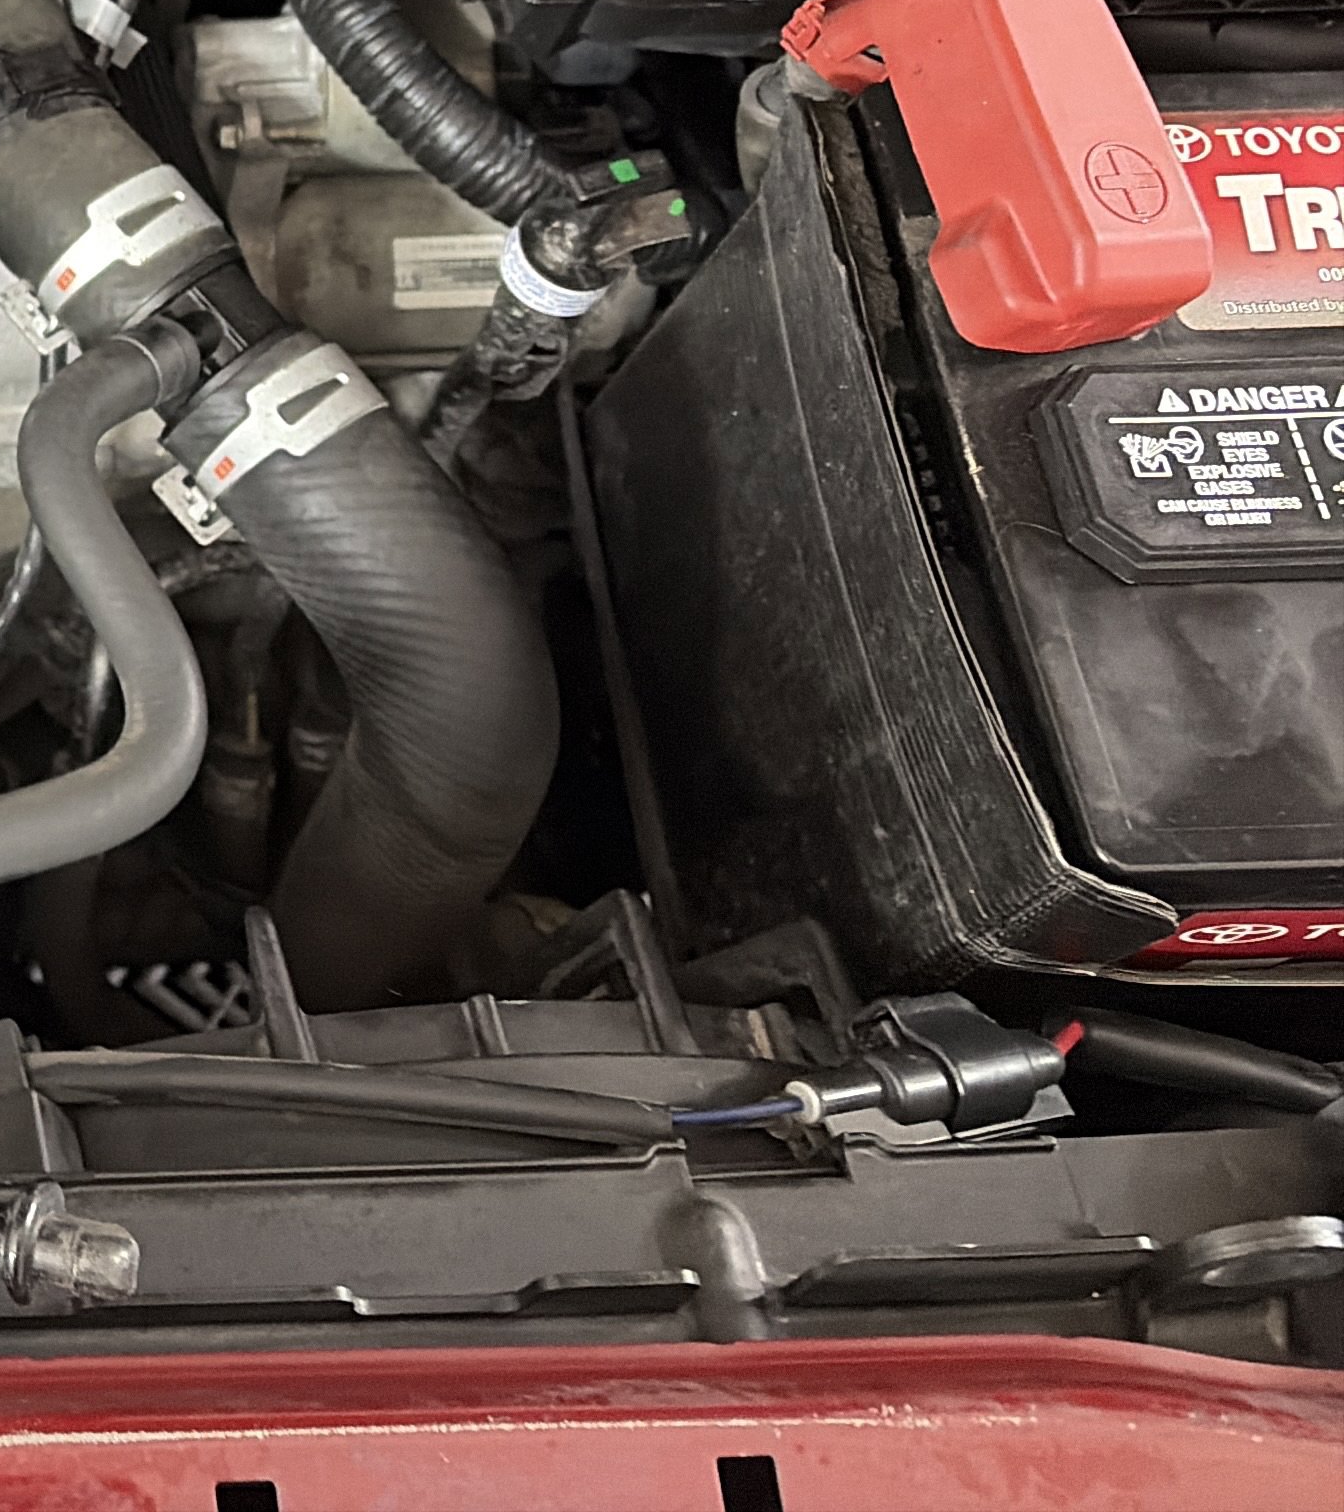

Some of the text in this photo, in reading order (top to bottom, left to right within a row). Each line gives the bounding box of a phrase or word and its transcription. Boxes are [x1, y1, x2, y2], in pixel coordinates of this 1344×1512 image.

[1214, 125, 1344, 157] TOYO
[1215, 173, 1344, 252] TR
[1318, 267, 1344, 282] 00
[1224, 296, 1320, 316] Distributed
[1189, 385, 1330, 412] DANGER
[1216, 431, 1280, 446] SHIELD
[1221, 448, 1270, 462] EYES
[1188, 463, 1284, 479] EXPLOSIVE
[1194, 480, 1255, 496] GASES
[1186, 499, 1231, 512] CAUSE
[1230, 496, 1303, 511] BLINDNESS
[1302, 923, 1344, 940] T
